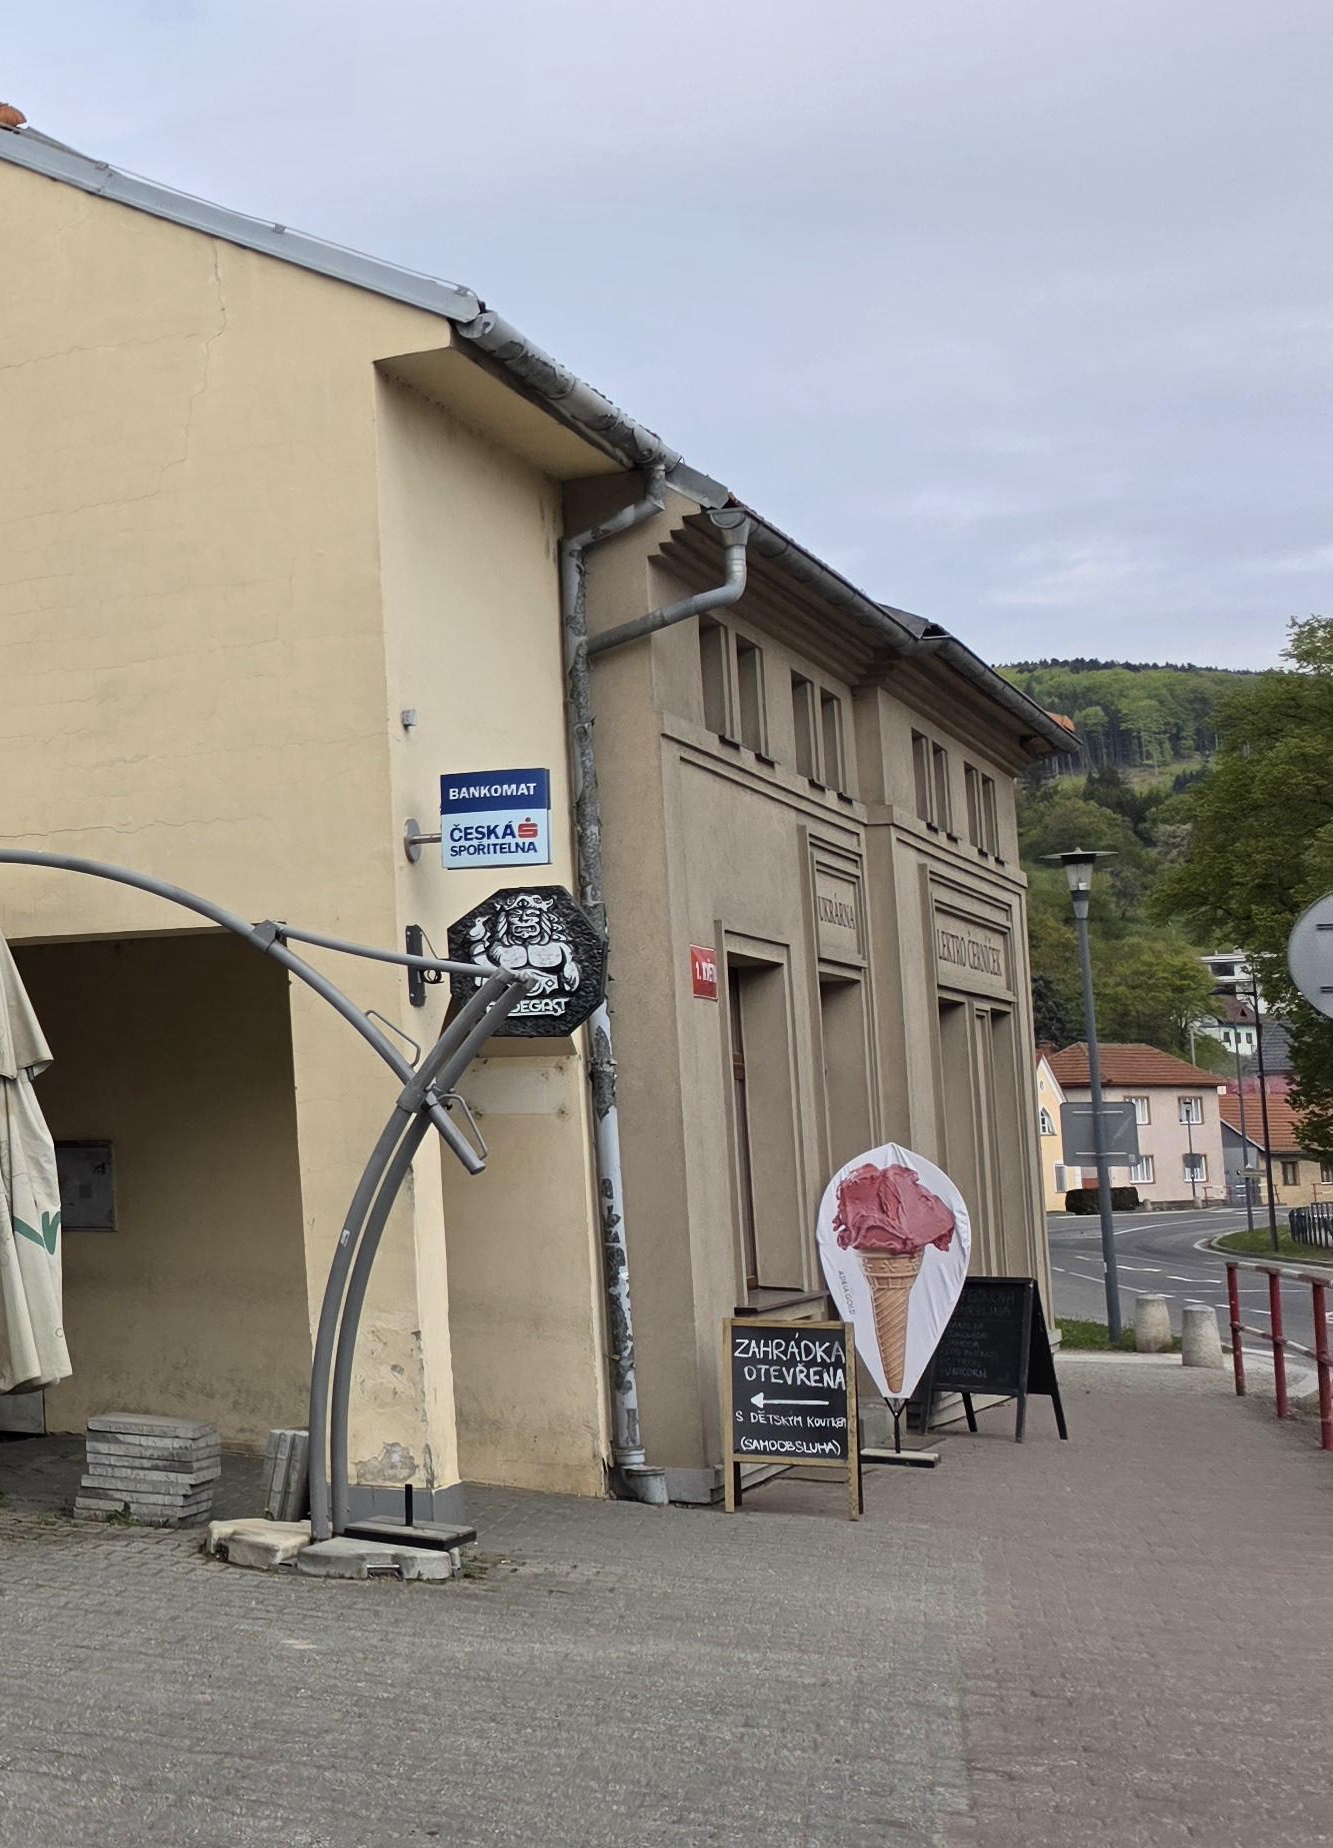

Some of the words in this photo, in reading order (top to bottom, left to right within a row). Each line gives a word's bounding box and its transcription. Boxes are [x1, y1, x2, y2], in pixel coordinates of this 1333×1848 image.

[449, 783, 536, 800] BANKOMAT
[449, 820, 516, 843] ČESKÁ
[450, 841, 538, 857] SPOŘITELNA
[818, 893, 855, 930] UKRÁRNA
[937, 929, 966, 967] LEKTRO
[734, 1332, 846, 1364] ZAHRÁDKA
[743, 1362, 846, 1391] OTEVŘENA
[735, 1410, 744, 1422] S
[740, 1436, 841, 1456] (SAMOOBSLUHA)
